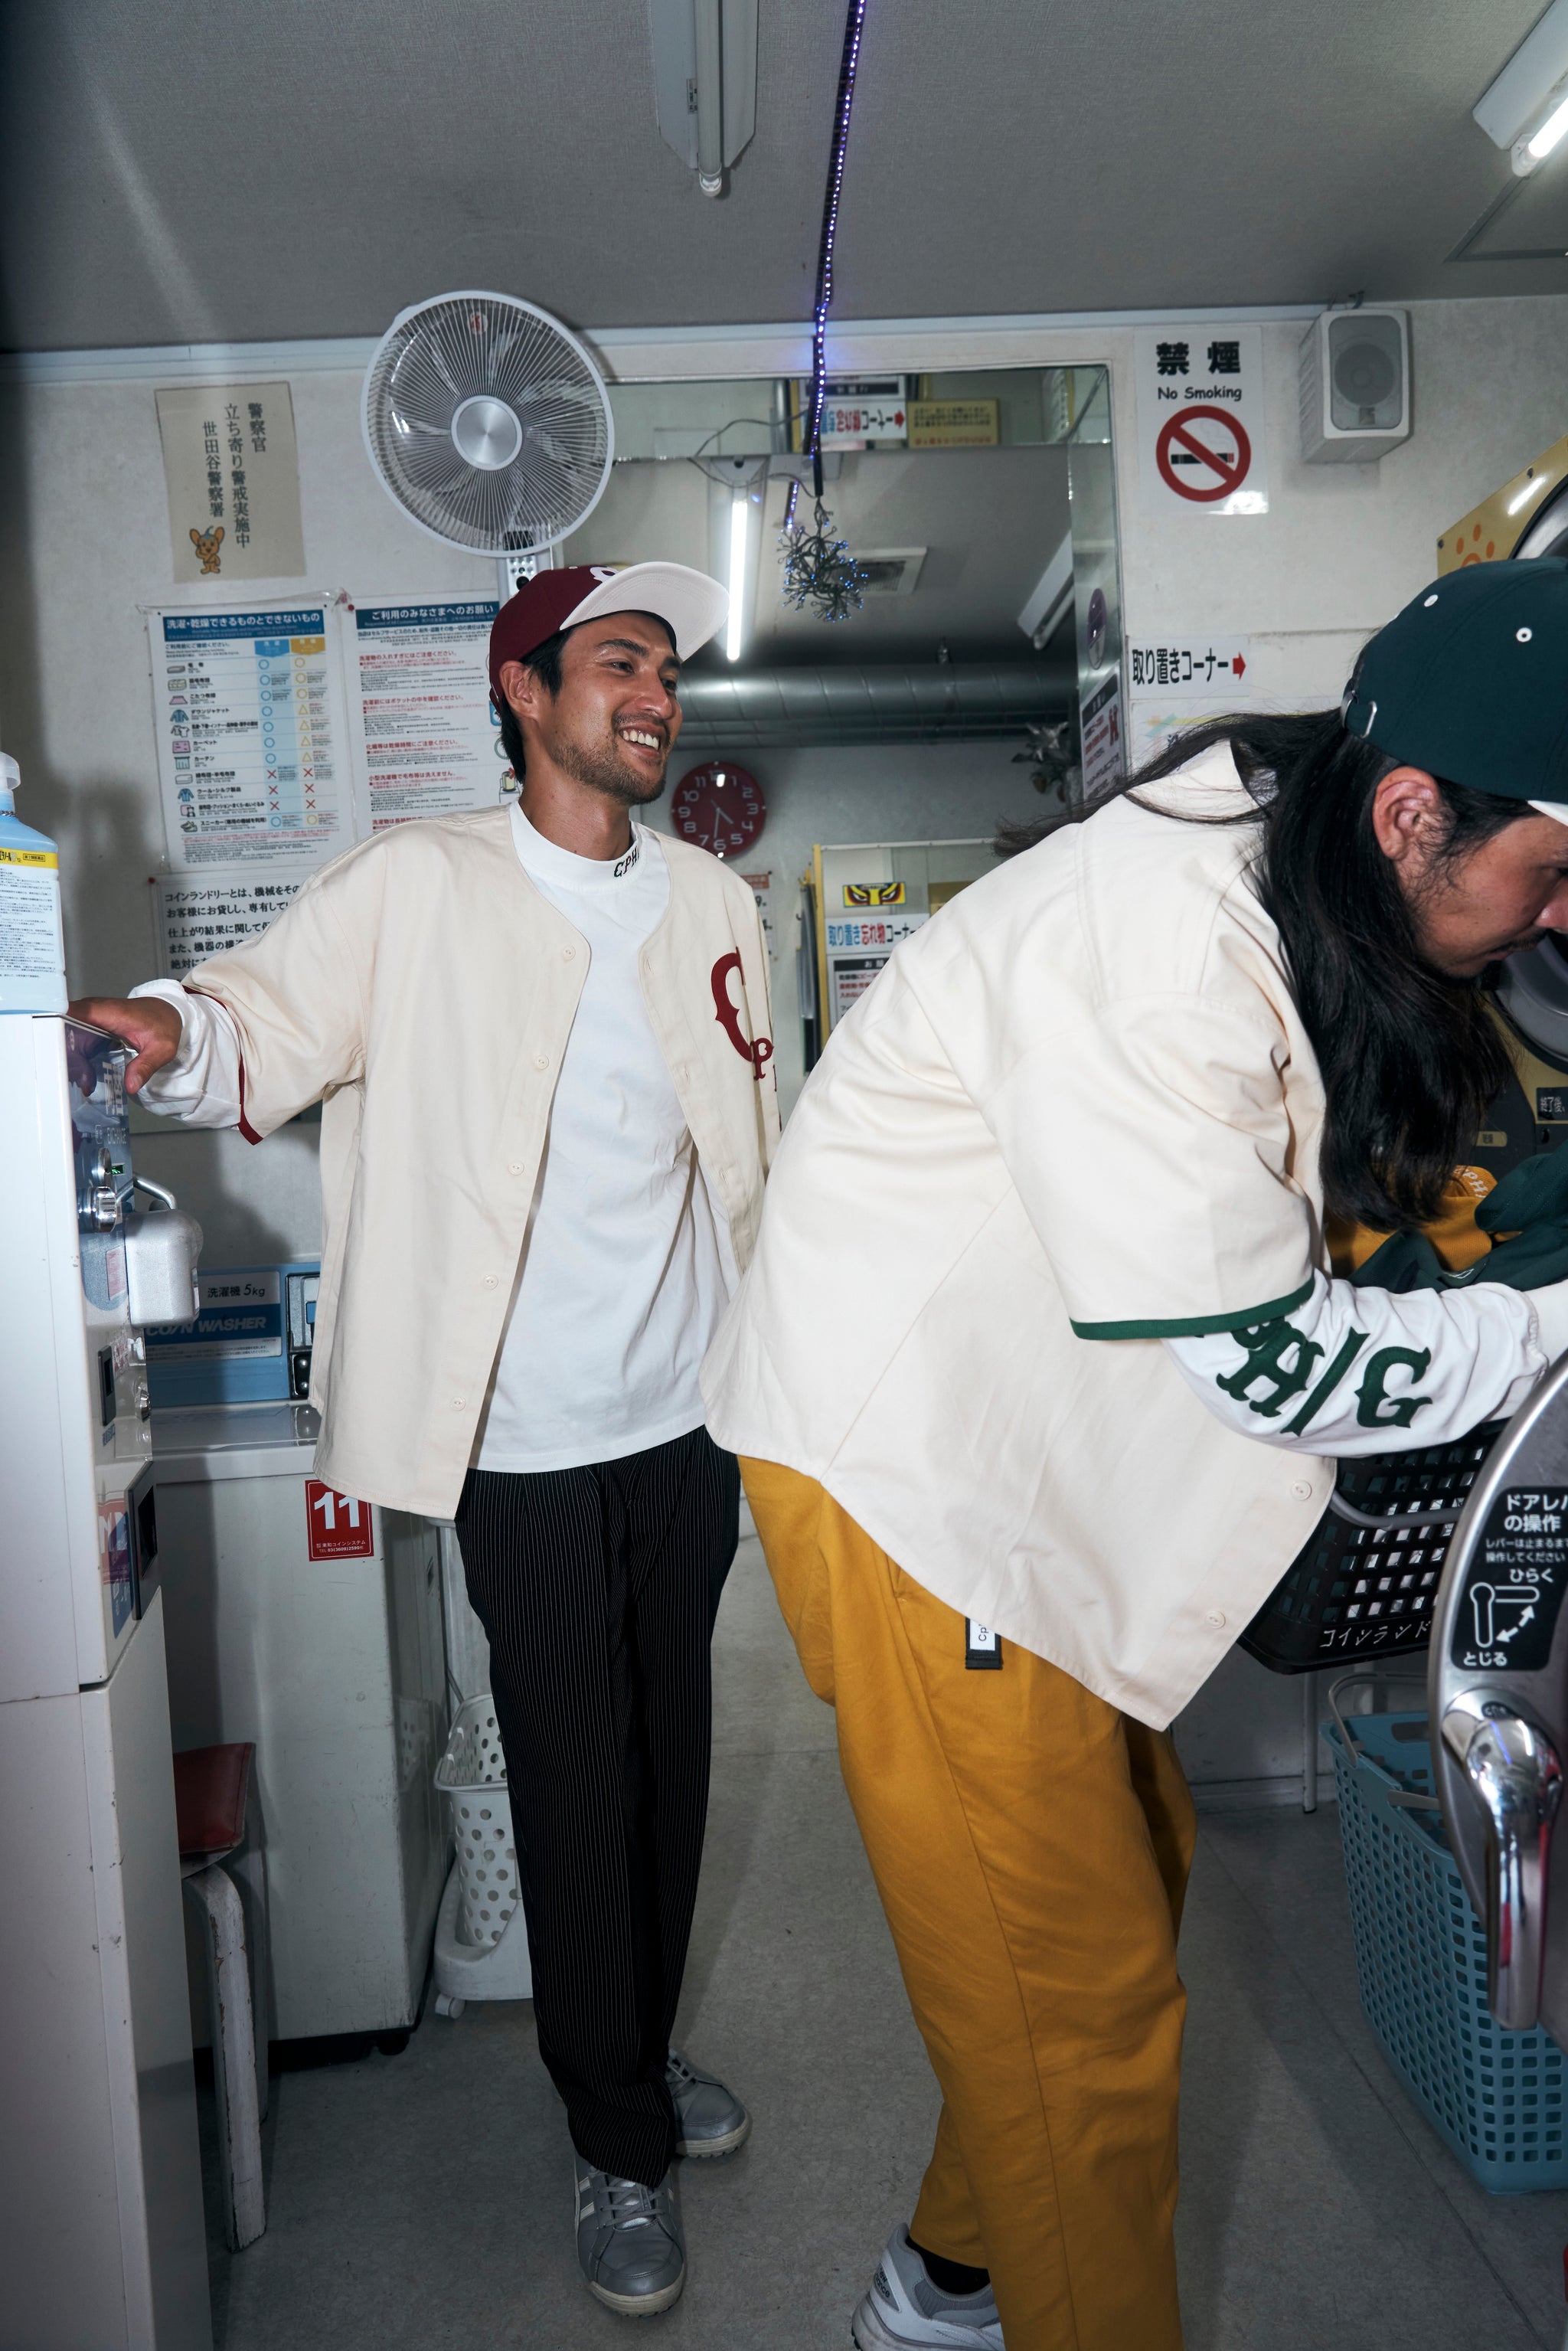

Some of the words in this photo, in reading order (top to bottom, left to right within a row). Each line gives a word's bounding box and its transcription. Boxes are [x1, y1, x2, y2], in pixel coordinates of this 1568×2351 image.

[1156, 341, 1240, 375] 禁煙
[1158, 387, 1178, 400] No
[1184, 385, 1242, 401] Smoking
[247, 403, 266, 453] 警察官
[203, 421, 224, 518] 世田谷警察署
[224, 404, 250, 548] 立ち寄り警戒実施中
[372, 605, 494, 620] ご利用のみなさまへのお願い
[1132, 648, 1229, 685] 取り置きコーナー
[683, 790, 699, 802] 10
[743, 786, 753, 798] 2
[678, 806, 691, 818] 9
[746, 803, 758, 815] 3
[684, 821, 696, 833] 8
[741, 821, 753, 832] 4
[698, 835, 709, 846] 7
[714, 839, 726, 851] 6
[730, 833, 743, 845] 5
[207, 1286, 240, 1299] 洗濯機
[243, 1284, 266, 1297] 5kg
[198, 1316, 266, 1334] WASHER
[314, 1491, 360, 1530] 11
[1504, 1515, 1562, 1532] の操作
[1509, 1568, 1554, 1583] ひらく
[1463, 1652, 1508, 1667] とじる
